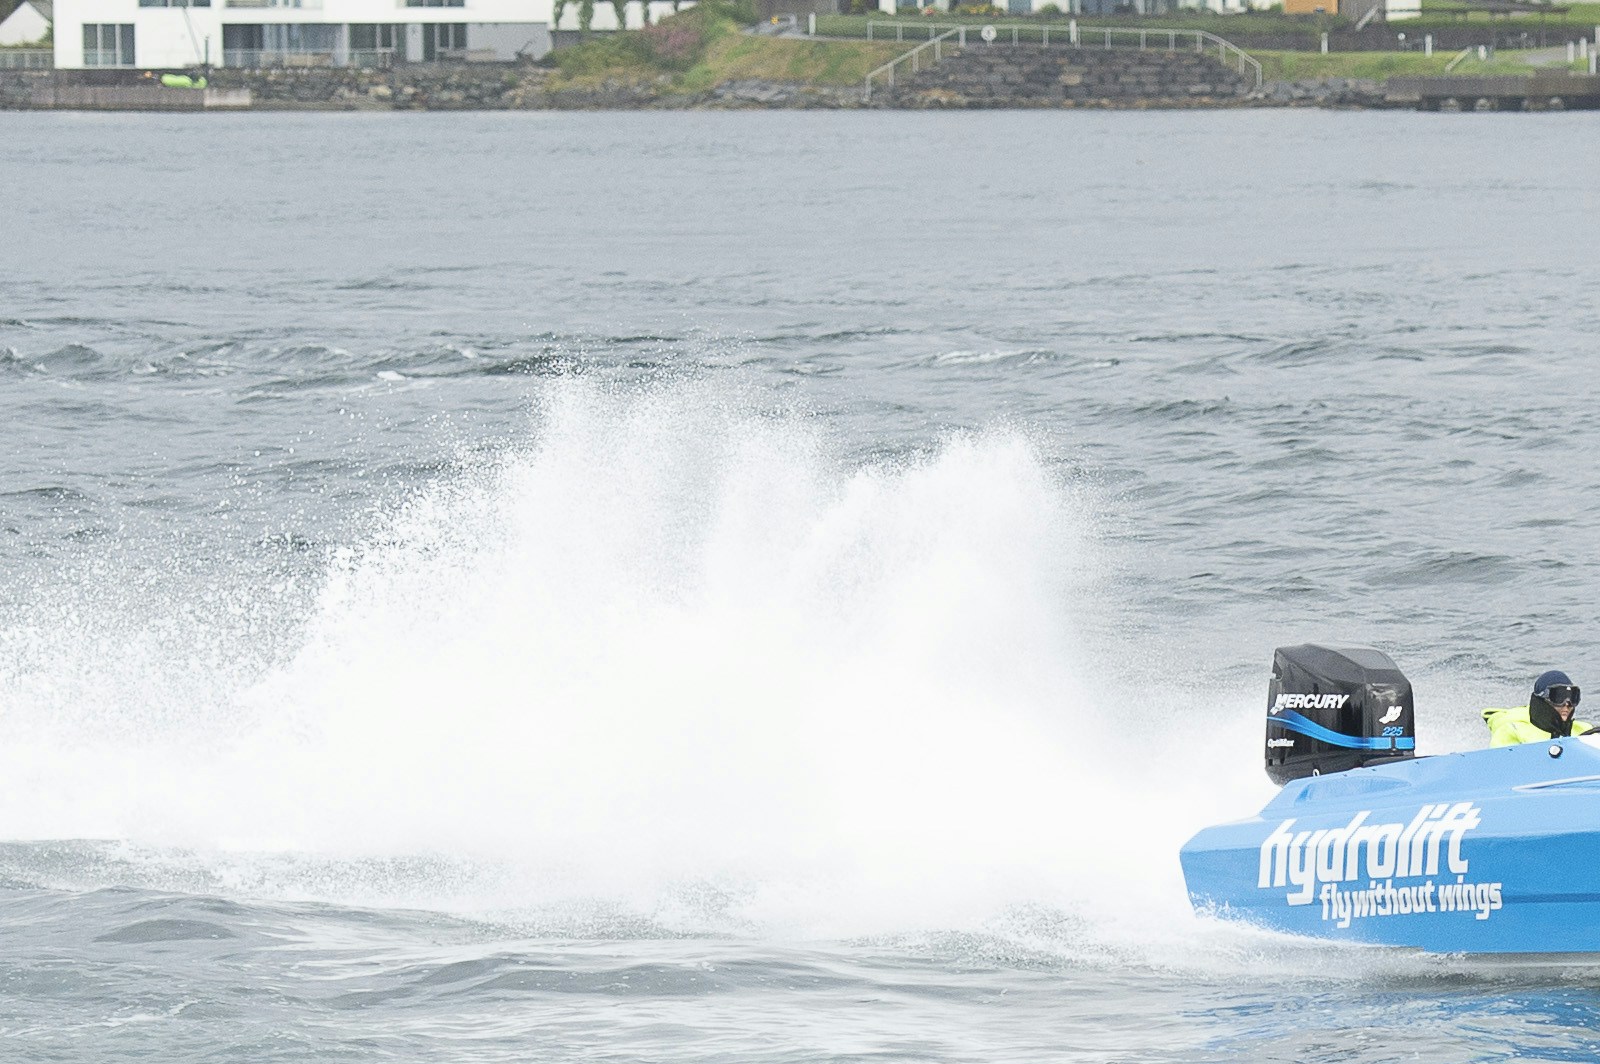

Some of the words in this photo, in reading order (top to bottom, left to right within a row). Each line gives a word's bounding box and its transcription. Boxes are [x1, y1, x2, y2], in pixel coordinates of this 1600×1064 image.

[1270, 693, 1350, 715] MERCURY
[1382, 726, 1404, 737] 225
[1257, 802, 1482, 906] hydrolift
[1319, 882, 1350, 928] fly
[1352, 879, 1436, 918] without
[1438, 875, 1502, 920] wings
